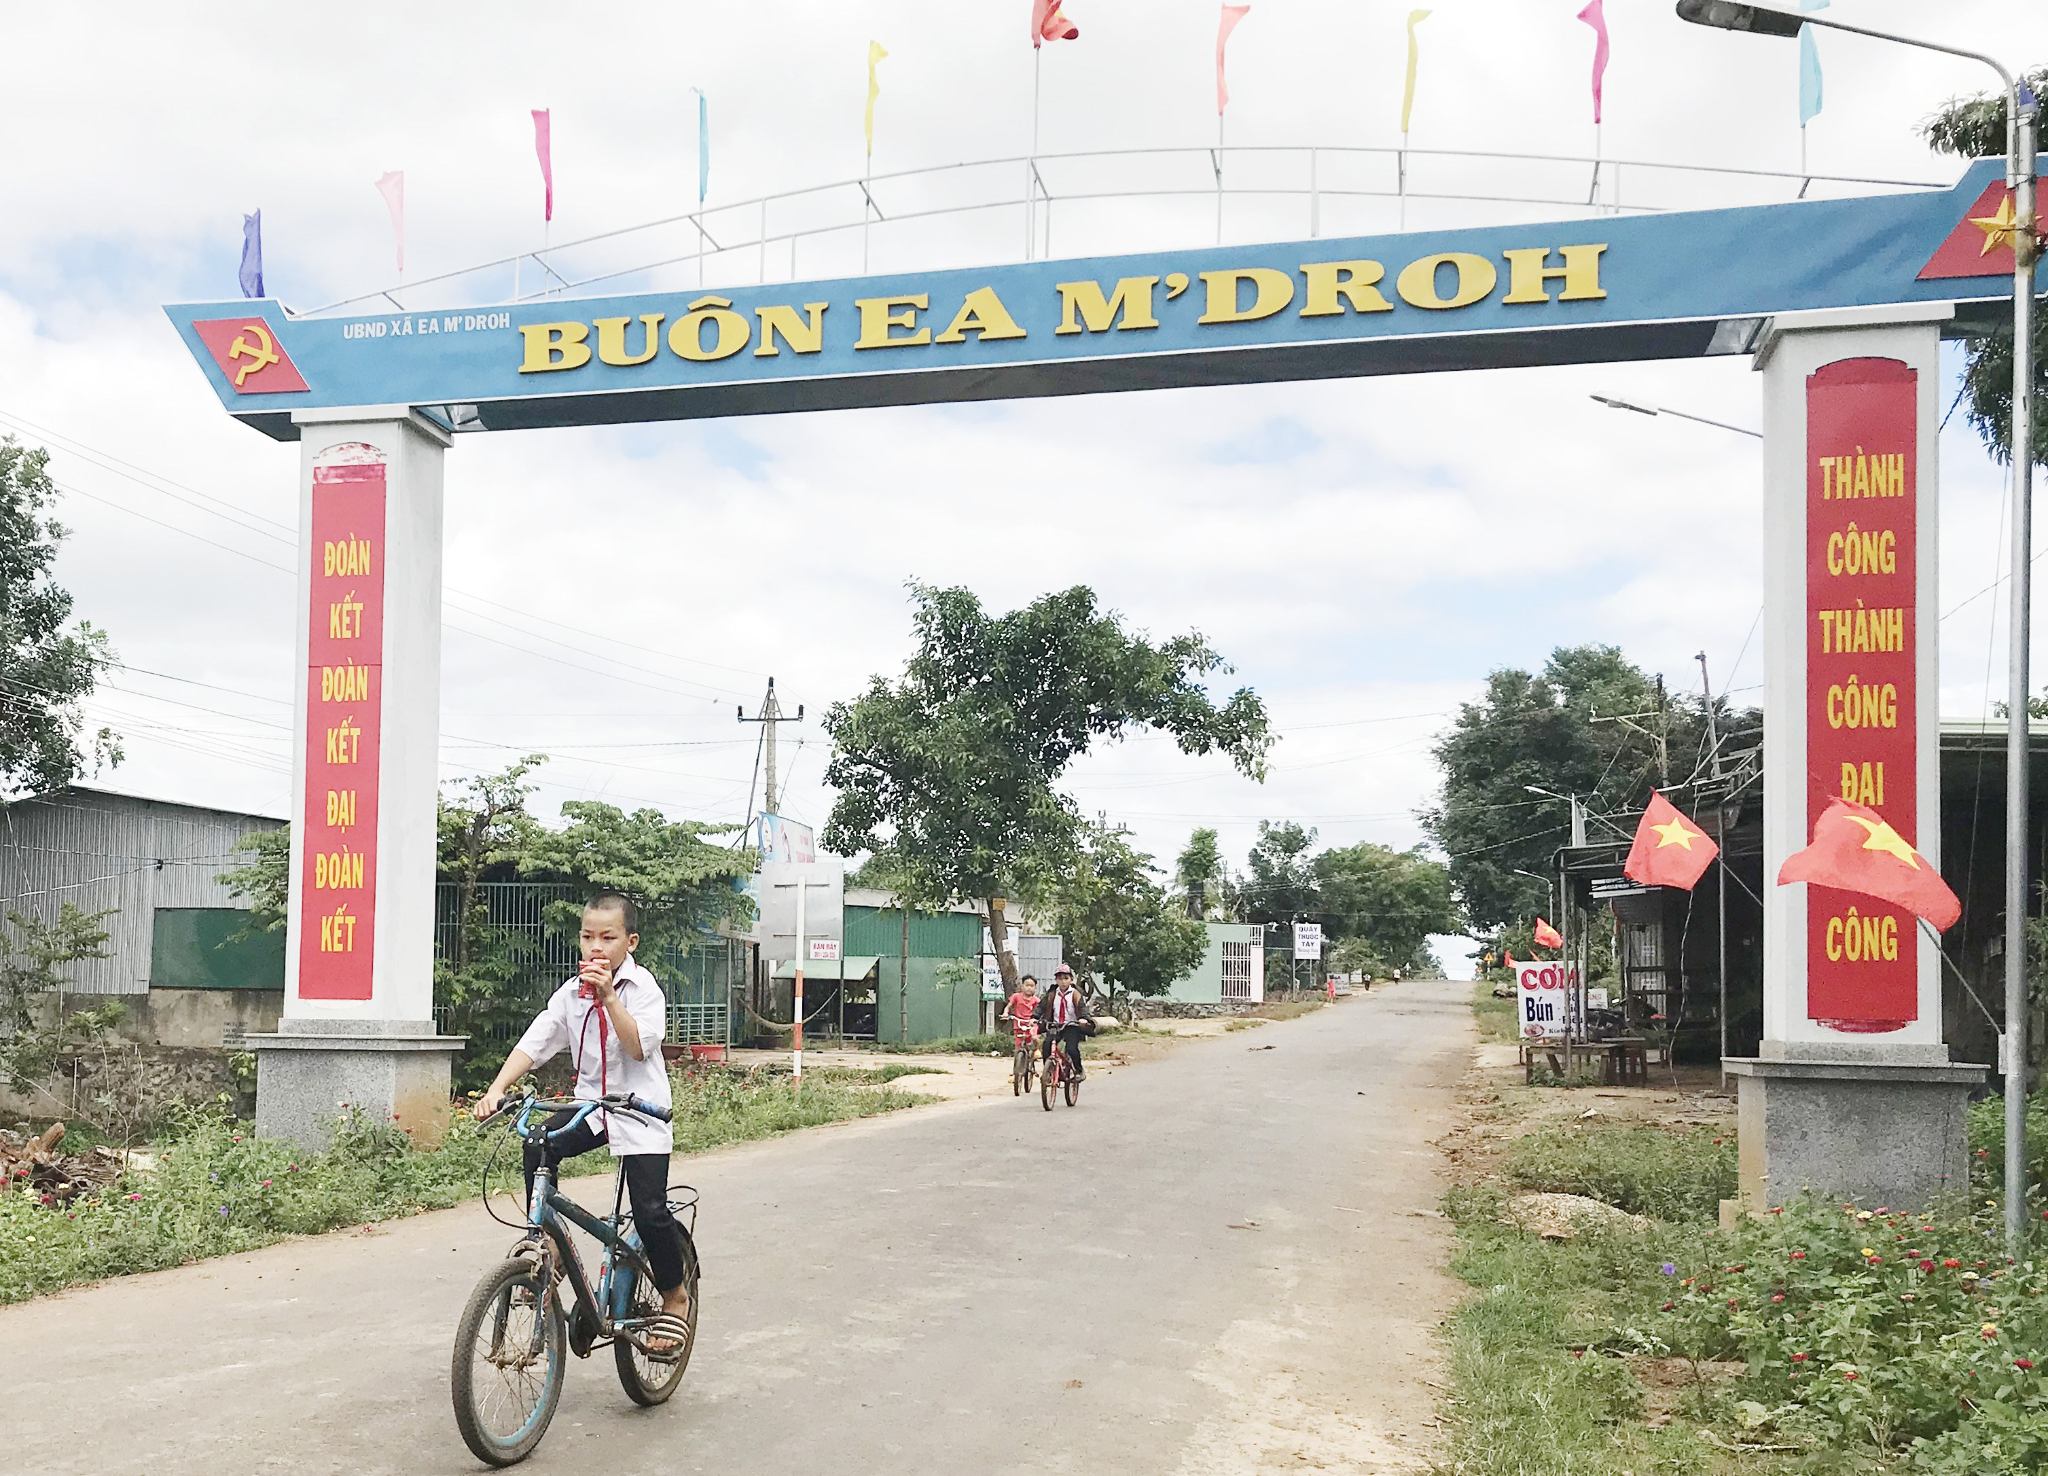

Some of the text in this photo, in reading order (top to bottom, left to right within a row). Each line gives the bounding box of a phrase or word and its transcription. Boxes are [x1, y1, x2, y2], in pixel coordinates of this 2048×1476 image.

[343, 321, 387, 339] UBND
[390, 316, 413, 336] XÃ
[418, 318, 440, 334] EA
[518, 296, 829, 373] BUÔN
[854, 287, 1028, 350] EA
[1819, 445, 1904, 500] THÀNH
[324, 532, 371, 577] ĐOÀN
[1826, 521, 1897, 577] CÔNG
[329, 590, 364, 639] KẾT
[1818, 598, 1904, 654] THÀNH
[321, 657, 369, 703] ĐOÀN
[1826, 674, 1897, 729] CÔNG
[326, 715, 361, 764] KẾT
[327, 790, 356, 834] ĐẠI
[315, 844, 364, 890] ĐOÀN
[320, 903, 357, 952] KẾT
[1826, 905, 1898, 962] CÔNG
[1525, 996, 1554, 1022] Bún
